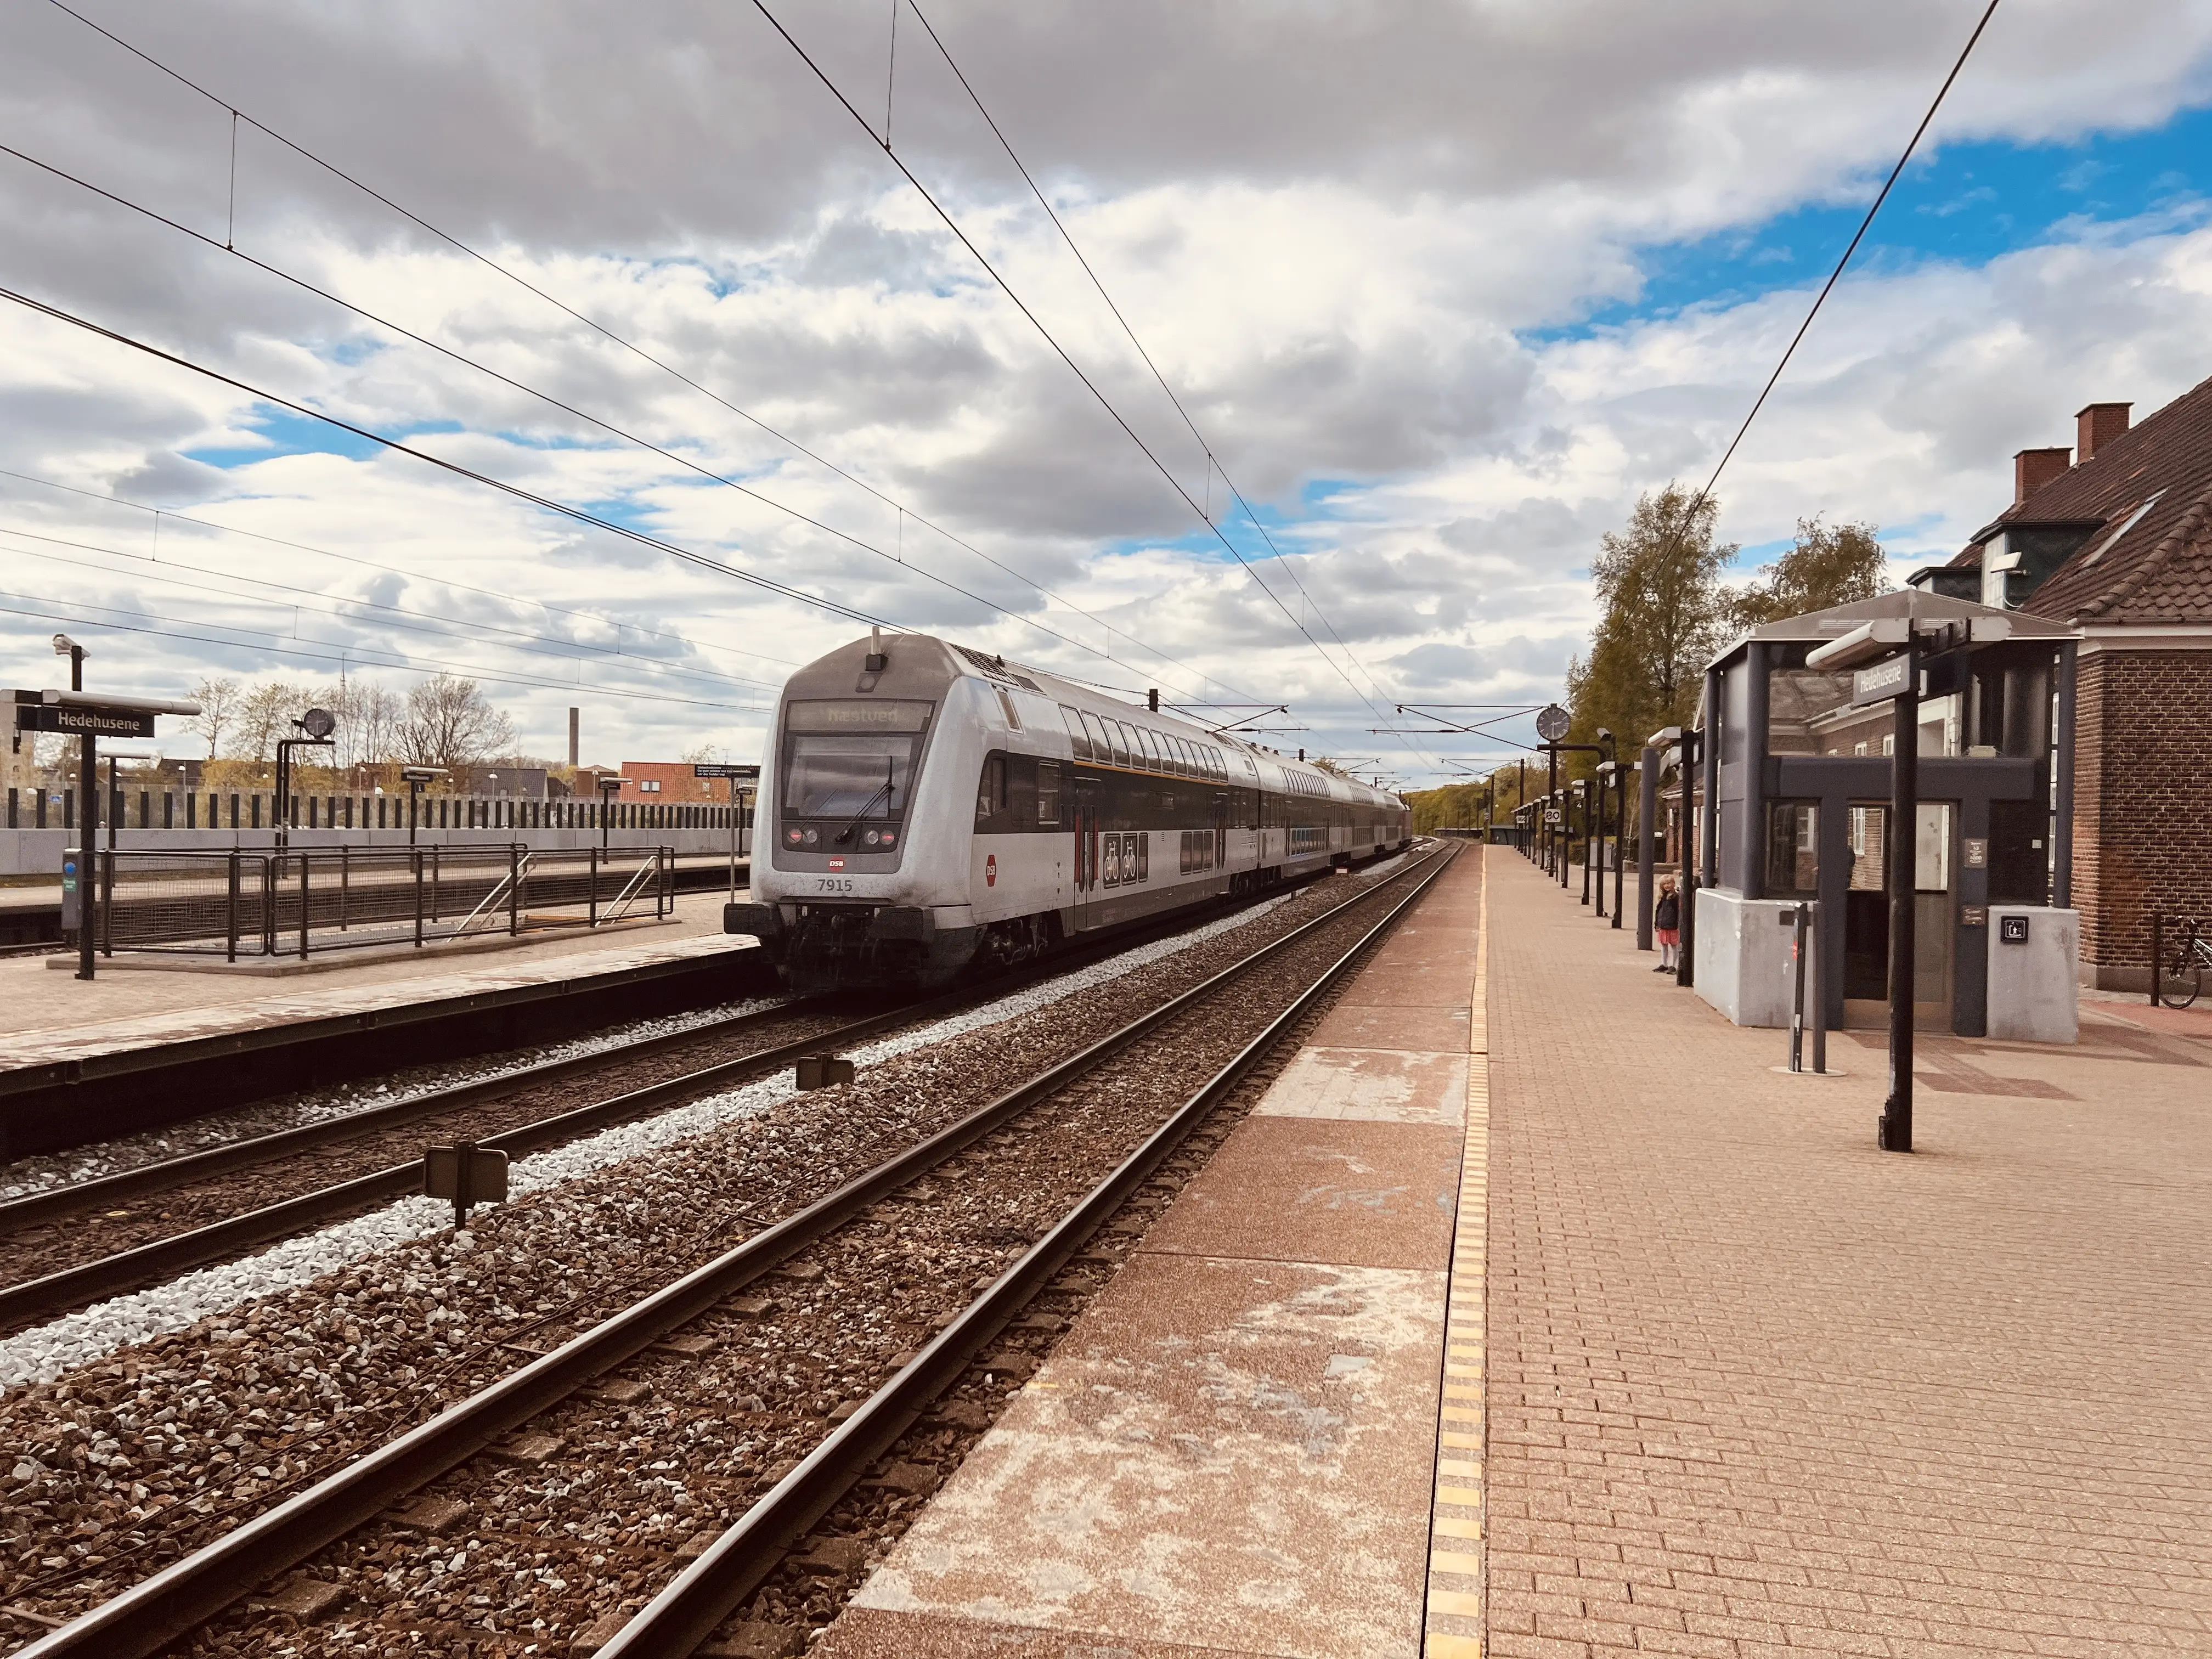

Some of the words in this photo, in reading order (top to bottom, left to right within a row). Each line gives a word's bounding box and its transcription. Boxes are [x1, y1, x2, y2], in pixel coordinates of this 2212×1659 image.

[58, 712, 140, 731] Hedehusene
[987, 865, 996, 876] DSB
[817, 879, 853, 891] 7915
